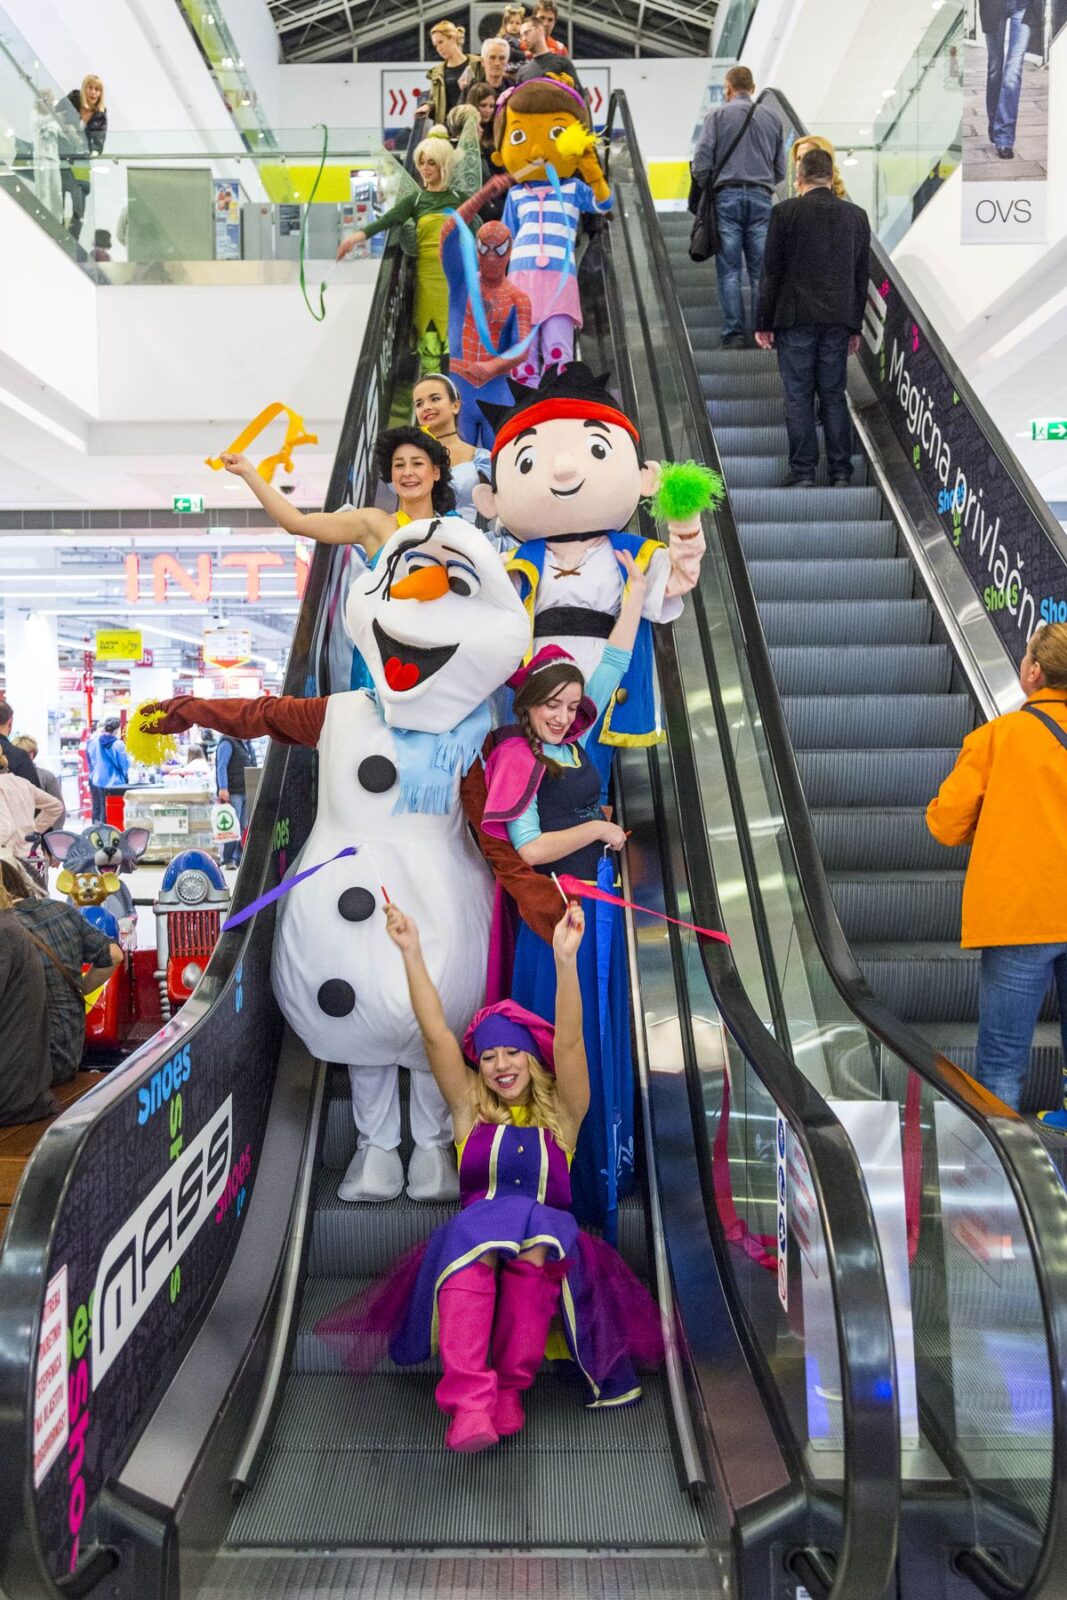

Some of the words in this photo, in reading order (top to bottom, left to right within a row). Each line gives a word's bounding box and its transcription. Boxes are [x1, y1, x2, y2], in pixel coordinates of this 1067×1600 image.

[975, 199, 1032, 224] OVS
[889, 337, 951, 487] Magična
[951, 466, 1048, 643] privlačn
[95, 1102, 232, 1368] MASS
